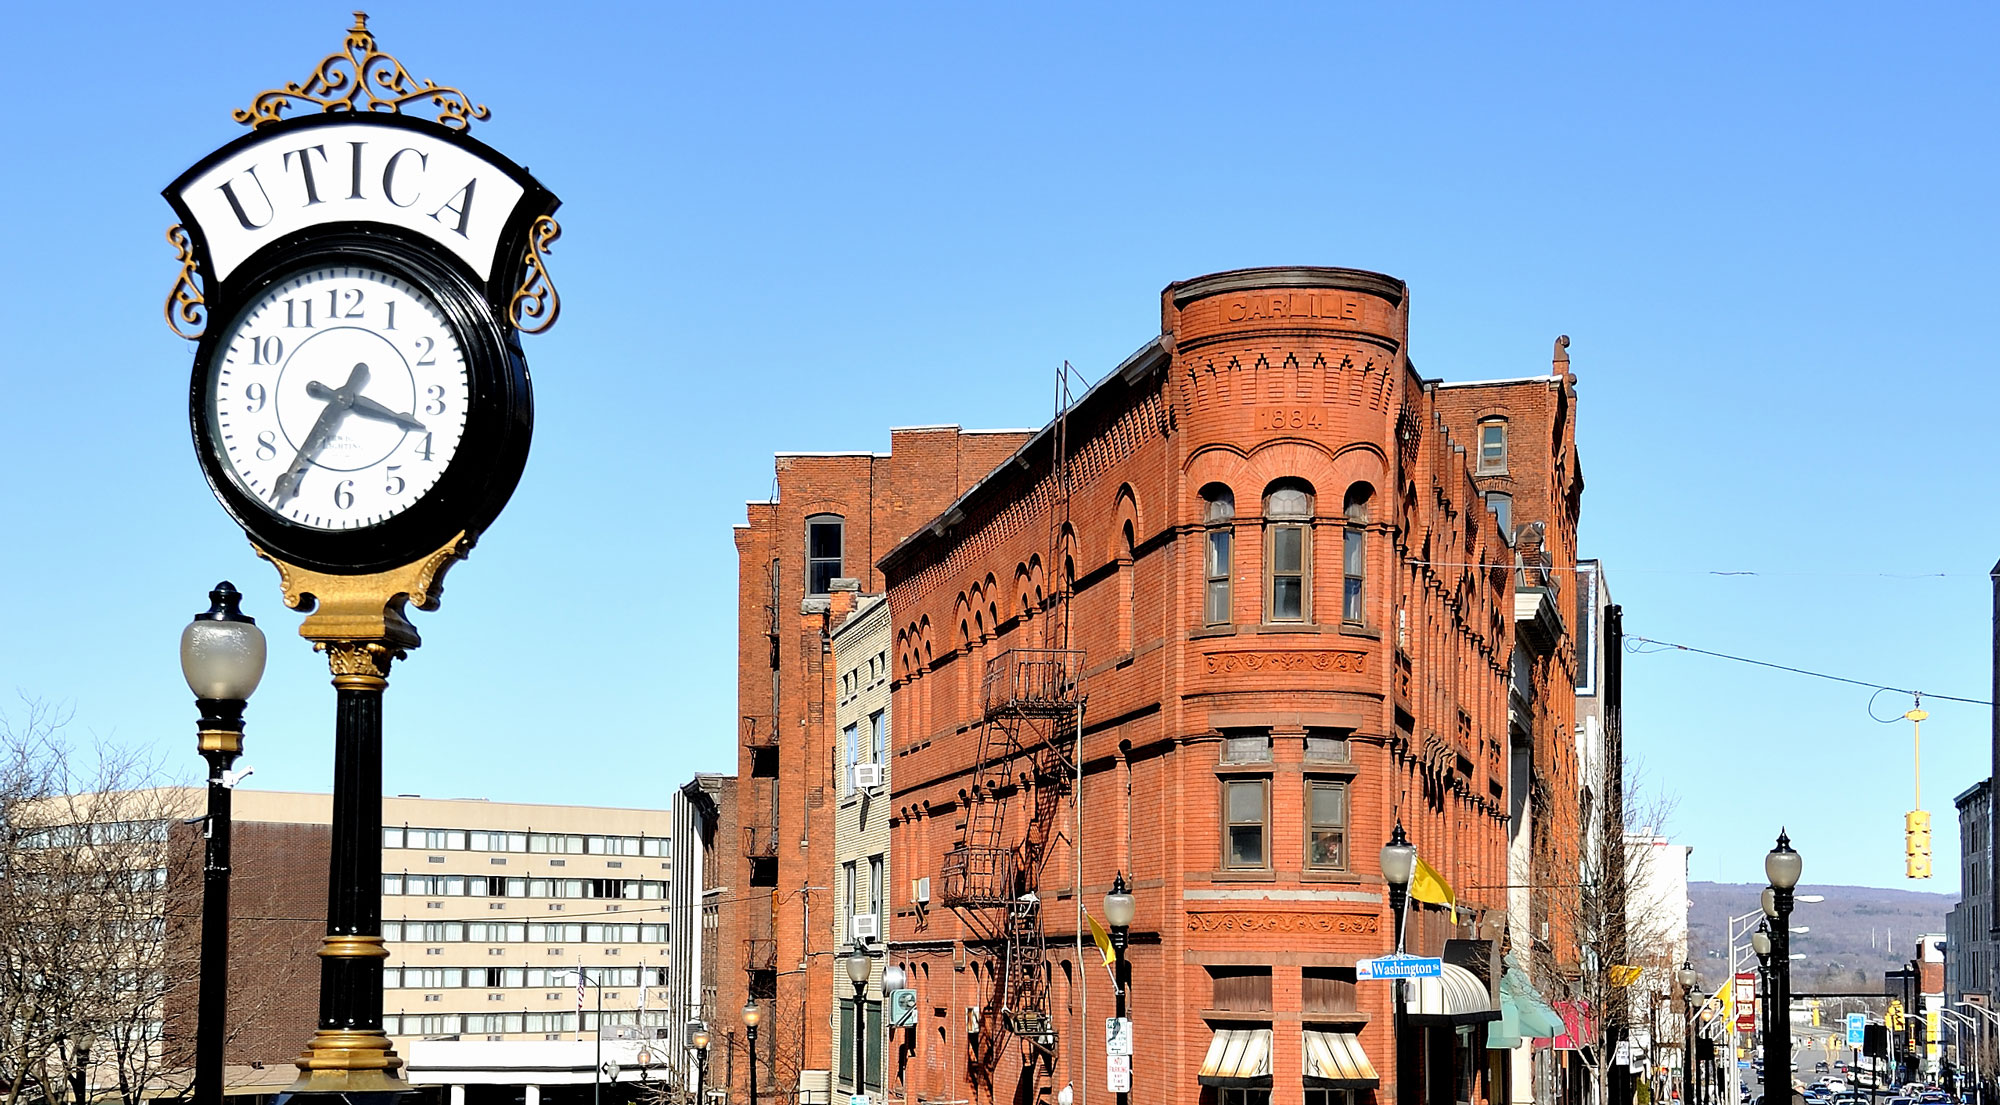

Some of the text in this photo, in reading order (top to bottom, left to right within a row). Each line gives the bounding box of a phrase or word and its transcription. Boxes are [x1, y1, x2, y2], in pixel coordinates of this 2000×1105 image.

[214, 141, 477, 241] UTICA
[283, 298, 314, 328] 11
[326, 289, 365, 319] 12
[384, 301, 398, 330] 1
[1228, 296, 1357, 321] CARLILE
[250, 336, 284, 366] 10
[415, 337, 436, 366] 2
[245, 383, 266, 413] 9
[426, 385, 446, 415] 3
[1261, 410, 1322, 429] 1884
[256, 430, 277, 461] 8
[414, 432, 435, 461] 4
[334, 480, 355, 510] 6
[386, 465, 405, 496] 5
[1373, 961, 1432, 977] Washington
